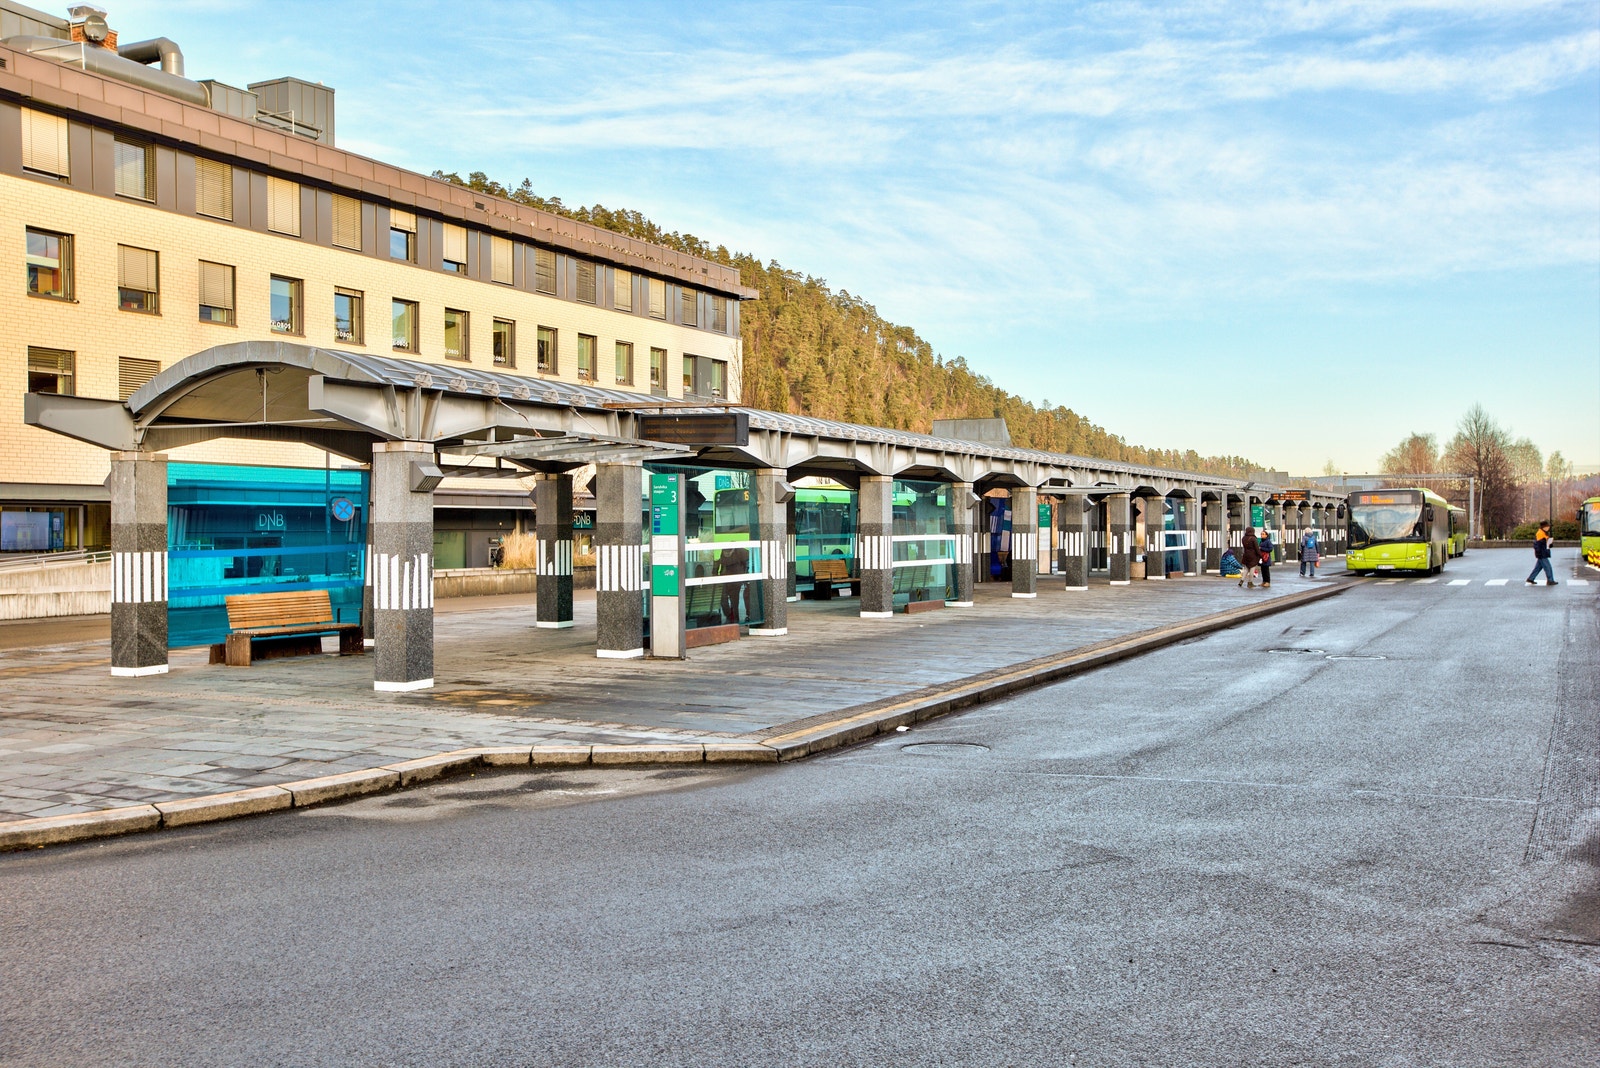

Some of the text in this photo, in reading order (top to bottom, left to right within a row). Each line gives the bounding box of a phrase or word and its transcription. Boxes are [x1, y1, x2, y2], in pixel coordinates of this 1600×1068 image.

[276, 321, 291, 330] OBOS
[338, 331, 353, 339] OBOS
[670, 490, 677, 503] 3
[259, 509, 284, 531] DNB
[575, 512, 591, 529] DNB
